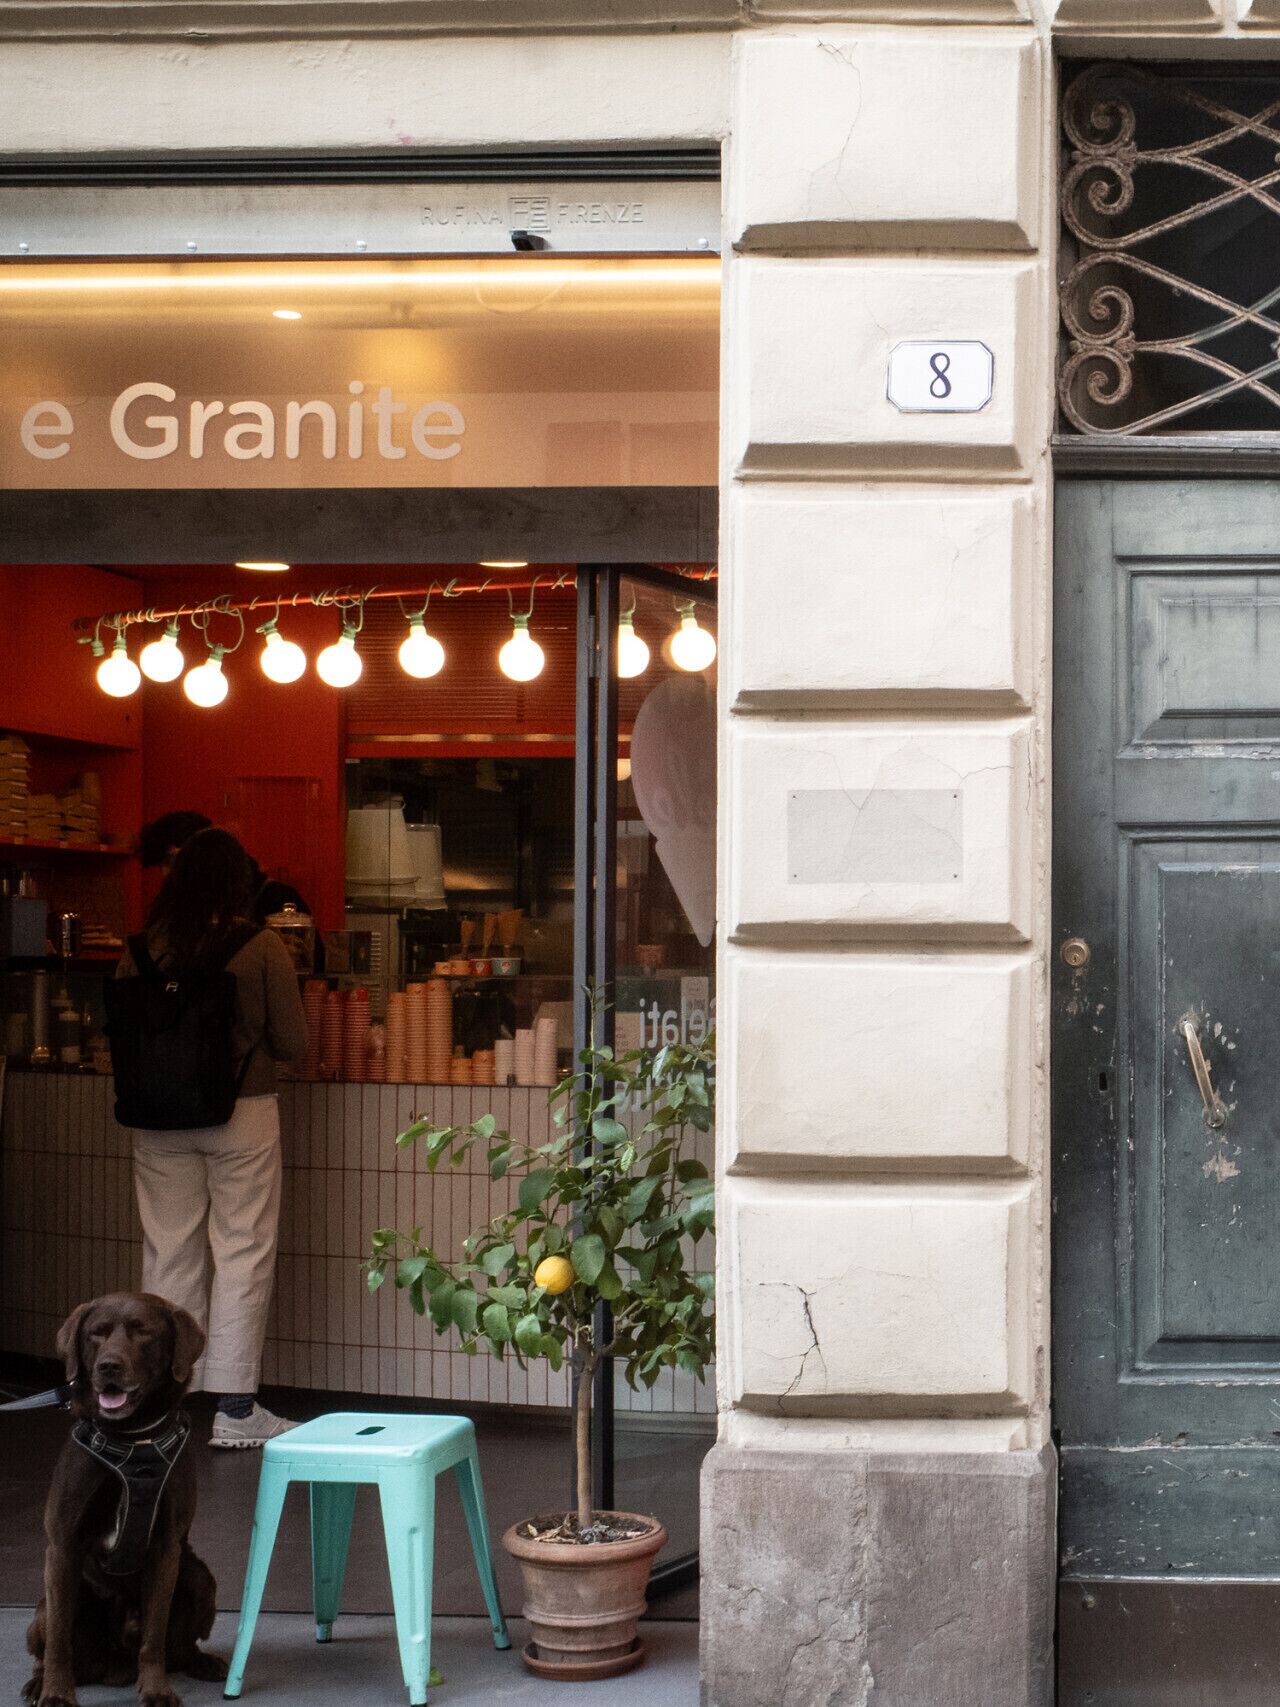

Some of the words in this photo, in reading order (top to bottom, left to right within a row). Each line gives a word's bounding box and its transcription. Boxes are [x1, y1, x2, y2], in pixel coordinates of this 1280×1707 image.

[421, 205, 503, 225] RUFINA
[557, 203, 644, 224] FIRENZE
[929, 352, 952, 399] 8
[20, 400, 75, 461] e
[109, 379, 466, 461] Granite
